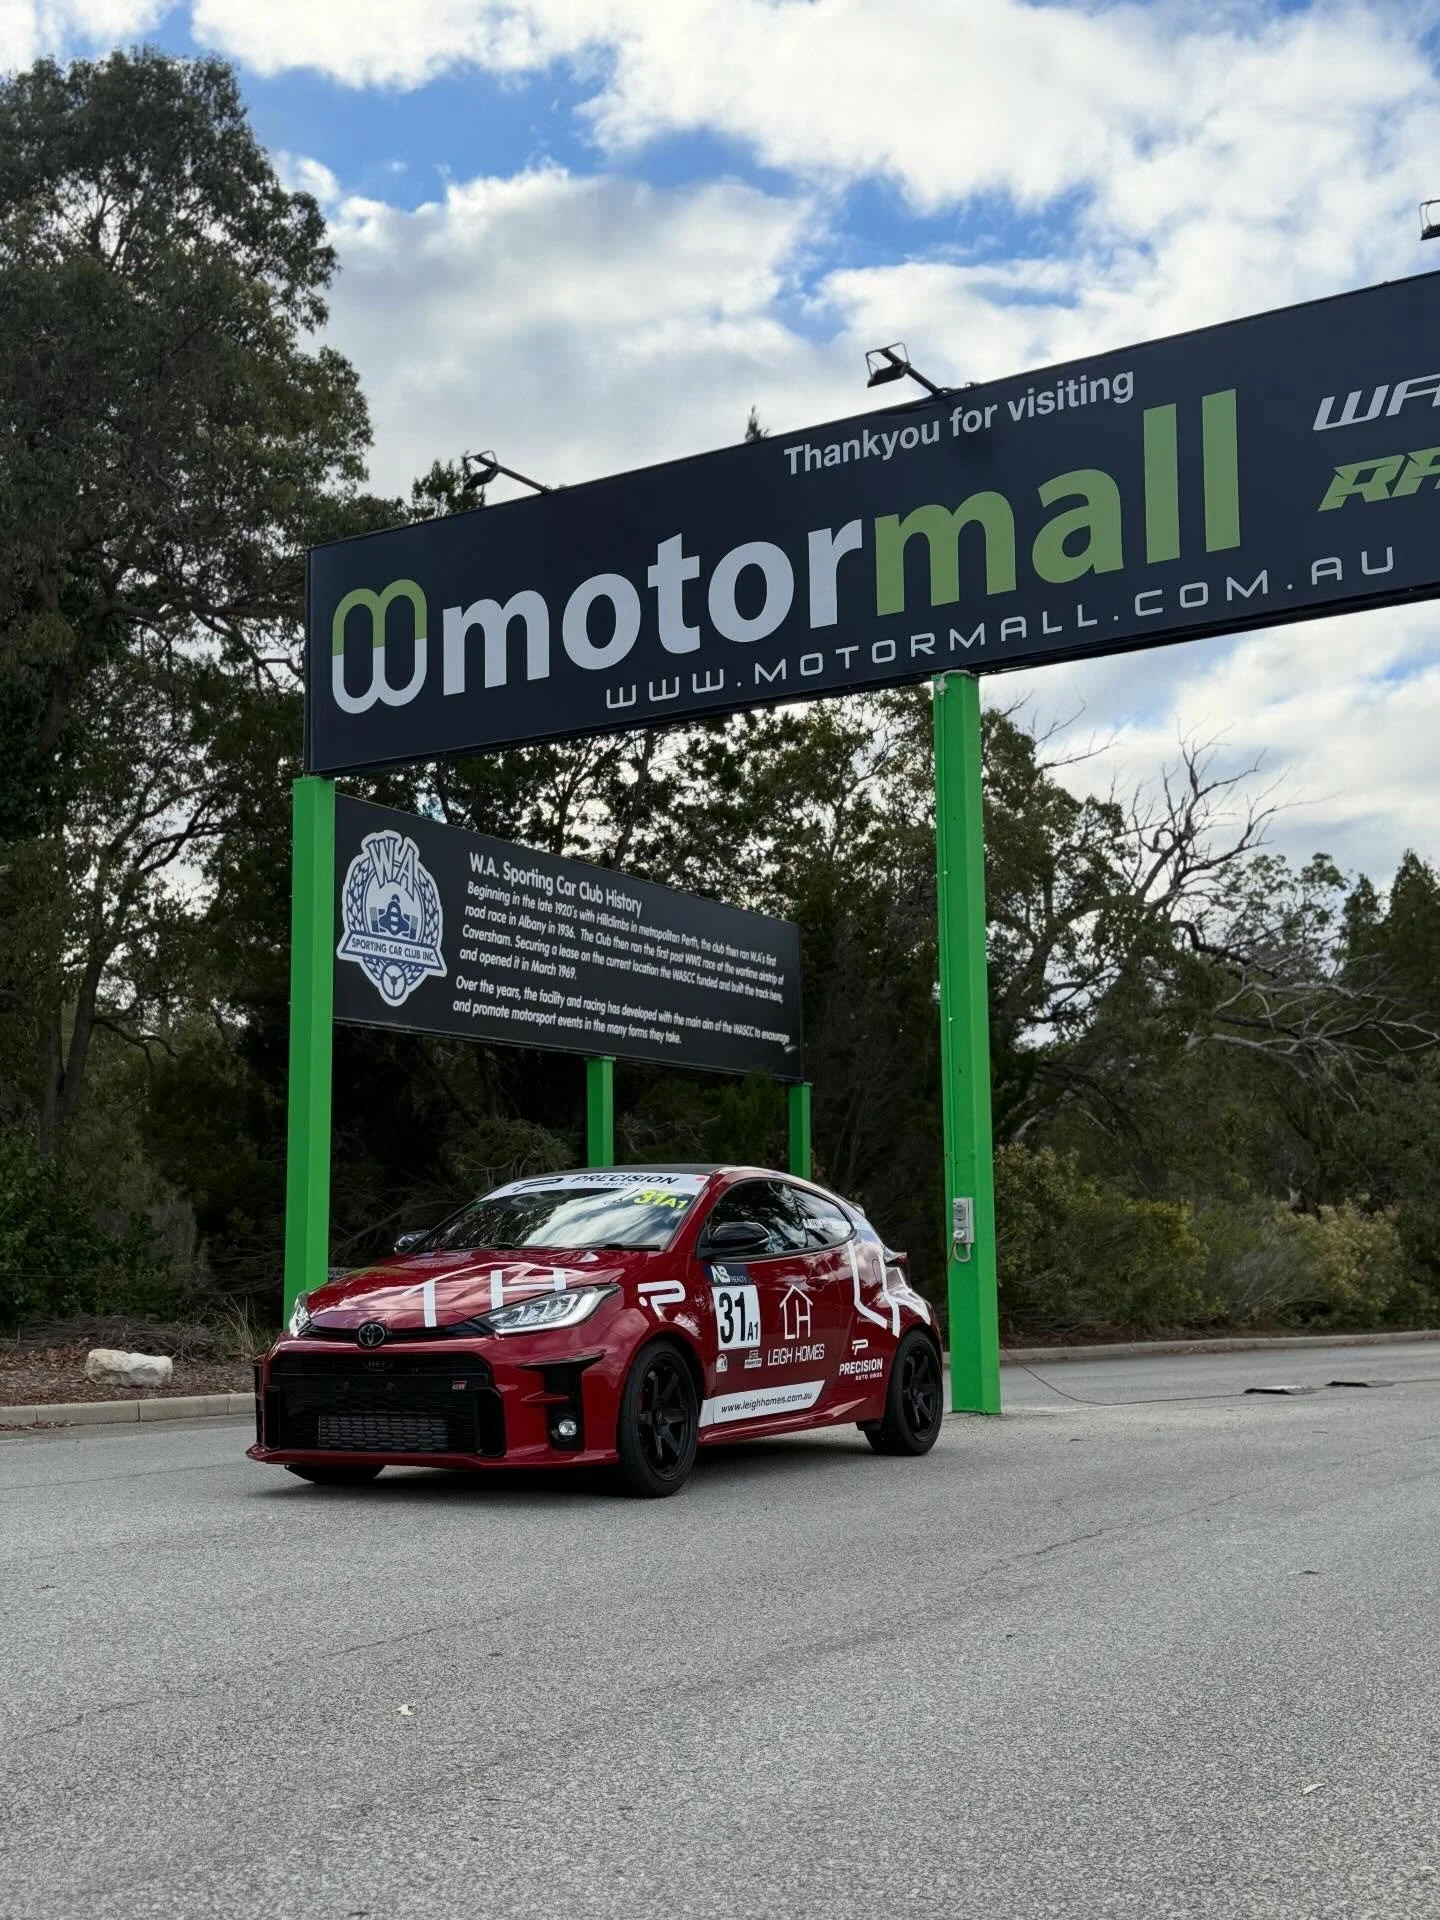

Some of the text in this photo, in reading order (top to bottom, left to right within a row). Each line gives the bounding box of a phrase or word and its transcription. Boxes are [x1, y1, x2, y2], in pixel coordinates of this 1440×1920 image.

[784, 370, 1135, 475] Thankyou for visiting
[442, 388, 1240, 696] motormall
[605, 546, 1395, 709] WWW.MOTORMALL.COM.AU
[469, 851, 643, 919] W.A. Sporting Car Club History
[351, 937, 436, 962] SPORTING CAR CLUB INC.
[464, 904, 487, 919] road
[487, 909, 507, 923] race
[508, 912, 517, 925] in
[518, 914, 546, 936] Albany
[548, 920, 556, 934] in
[557, 922, 576, 939] 1936.
[580, 927, 594, 943] The
[595, 931, 611, 947] Club
[613, 935, 629, 951] then
[630, 941, 643, 954] ran
[643, 943, 655, 957] the
[656, 945, 669, 960] first
[669, 949, 685, 964] post
[685, 953, 702, 967] WW2
[702, 959, 716, 970] race
[724, 962, 735, 975] the
[467, 881, 510, 906] Beginning
[512, 892, 520, 905] in
[522, 894, 536, 909] the
[537, 897, 553, 913] late
[579, 908, 596, 923] with
[597, 911, 630, 932] Hillclimbs
[630, 920, 638, 934] in
[638, 925, 680, 943] metropolitan
[681, 933, 700, 950] Perth,
[701, 938, 712, 951] the
[712, 941, 725, 955] club
[725, 944, 739, 958] then
[740, 950, 750, 961] ran
[459, 947, 577, 980] and opened it in March 1969.
[462, 924, 513, 946] Caversham.
[514, 935, 550, 957] Securing
[551, 944, 557, 955] a
[558, 944, 579, 960] lease
[580, 949, 591, 961] on
[592, 951, 605, 965] the
[606, 954, 632, 970] current
[632, 959, 659, 977] location
[660, 965, 671, 979] the
[672, 968, 696, 984] WASCC
[696, 973, 719, 989] funded
[719, 979, 731, 992] and
[452, 999, 682, 1044] and promote motorsport events in the many forms they take.
[456, 975, 479, 991] Over
[479, 979, 494, 994] the
[496, 984, 521, 1000] years,
[523, 986, 538, 1001] the
[539, 988, 566, 1009] facility
[566, 995, 582, 1009] and
[583, 997, 606, 1016] racing
[607, 1000, 620, 1014] has
[621, 1003, 657, 1022] developed
[658, 1009, 673, 1023] with
[673, 1013, 685, 1026] the
[685, 1016, 701, 1028] main
[702, 1018, 714, 1030] aim
[714, 1020, 722, 1031] of
[722, 1021, 733, 1034] the
[733, 1023, 754, 1039] WASCC
[754, 1027, 761, 1039] to
[570, 1174, 681, 1185] PRECISION
[718, 1291, 759, 1344] 31 A1
[767, 1347, 793, 1366] LEIGH
[795, 1343, 825, 1363] HOMES
[838, 1357, 883, 1376] PRECISION
[720, 1392, 813, 1414] www.leighhomes.com.au
